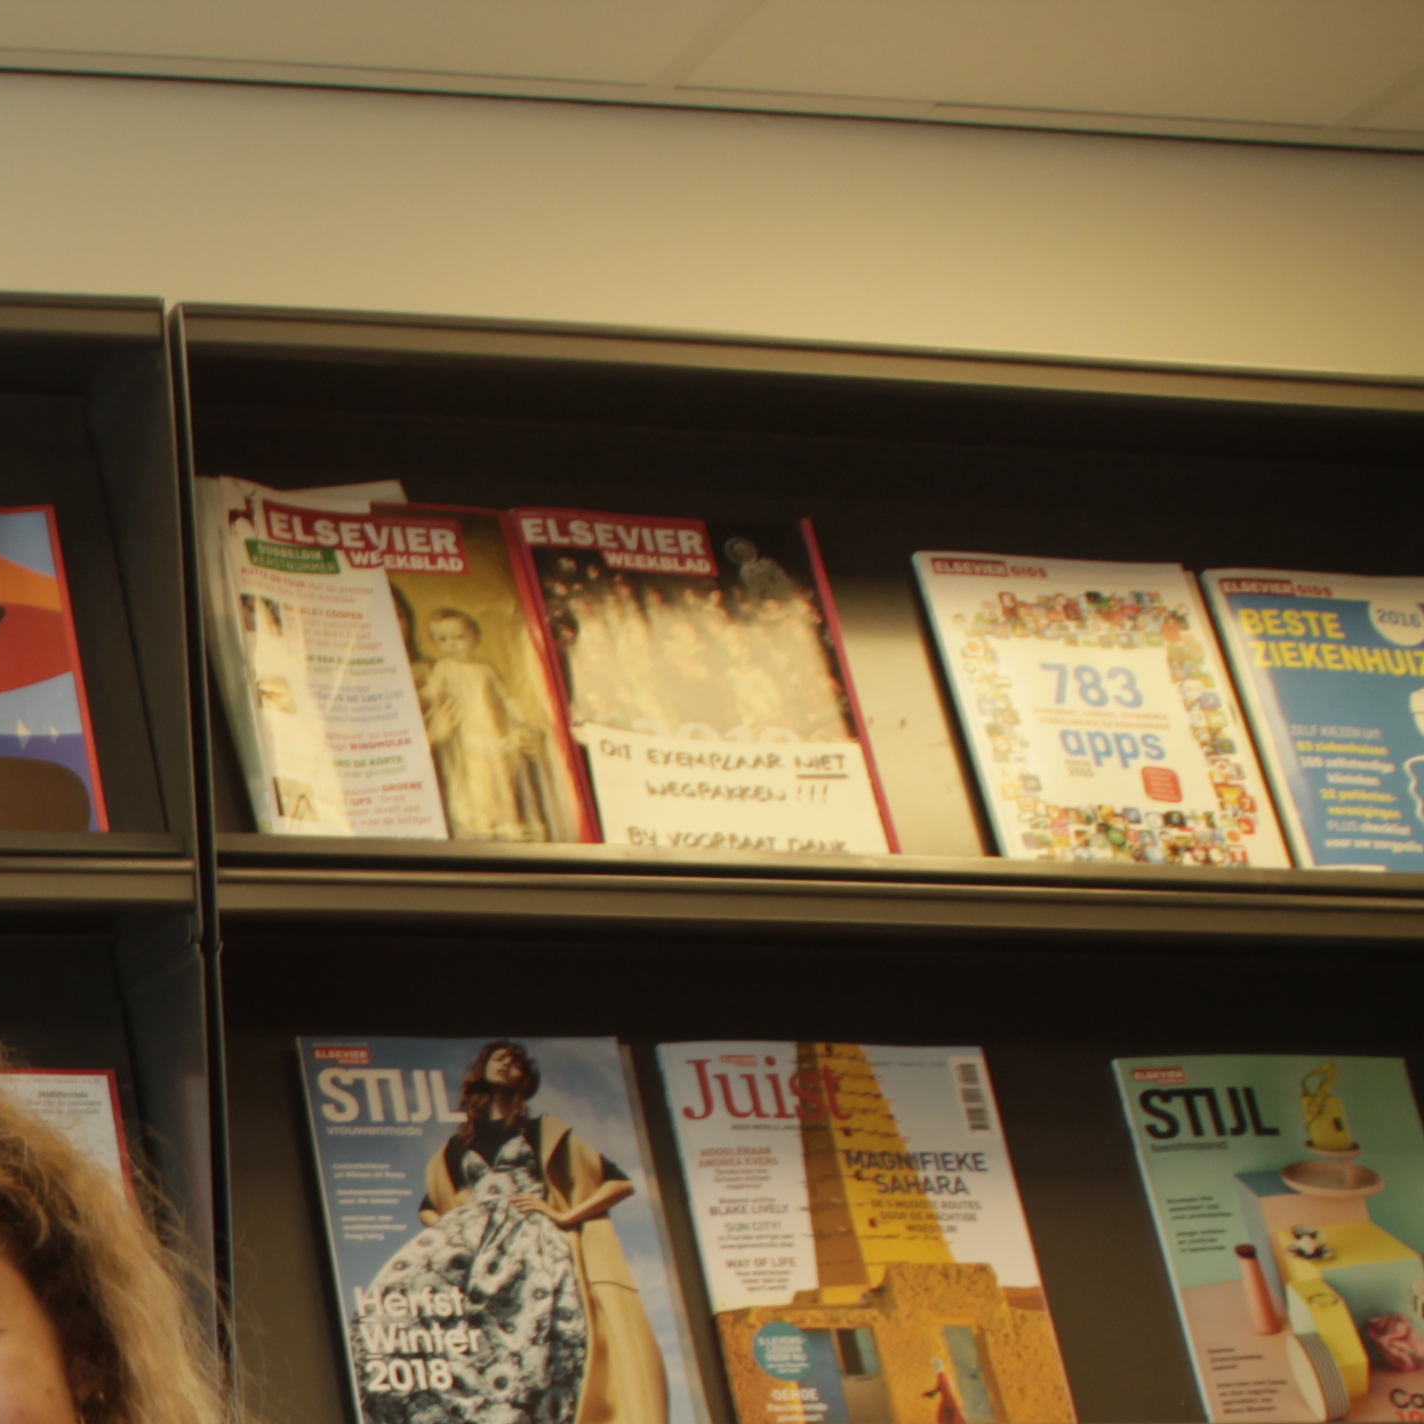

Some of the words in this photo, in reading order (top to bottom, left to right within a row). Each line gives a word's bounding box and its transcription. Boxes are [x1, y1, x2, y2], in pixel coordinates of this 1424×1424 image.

[270, 511, 458, 554] ELSEVIER
[521, 518, 706, 555] ELSEVIER
[352, 550, 464, 571] WEEKBLAD
[605, 550, 711, 573] WEEKBLAD
[1238, 609, 1345, 639] BESTE
[1377, 609, 1421, 627] 2016
[1039, 663, 1143, 708] 783
[600, 739, 631, 760] DIT
[648, 749, 783, 770] EXEMPLAAR
[795, 754, 846, 771] NIET
[1060, 729, 1165, 769] apps
[646, 781, 786, 802] WEGPAKKEN
[318, 1068, 468, 1122] STIJL
[683, 1056, 854, 1121] Juist
[1139, 1087, 1279, 1139] STIJL
[327, 1126, 423, 1136] vrouwenmode
[845, 1152, 988, 1172] MAGNIFIEKE
[874, 1175, 970, 1195] SAHARA
[356, 1286, 466, 1322] Herfst
[360, 1322, 481, 1359] Winter
[368, 1359, 455, 1393] 2018
